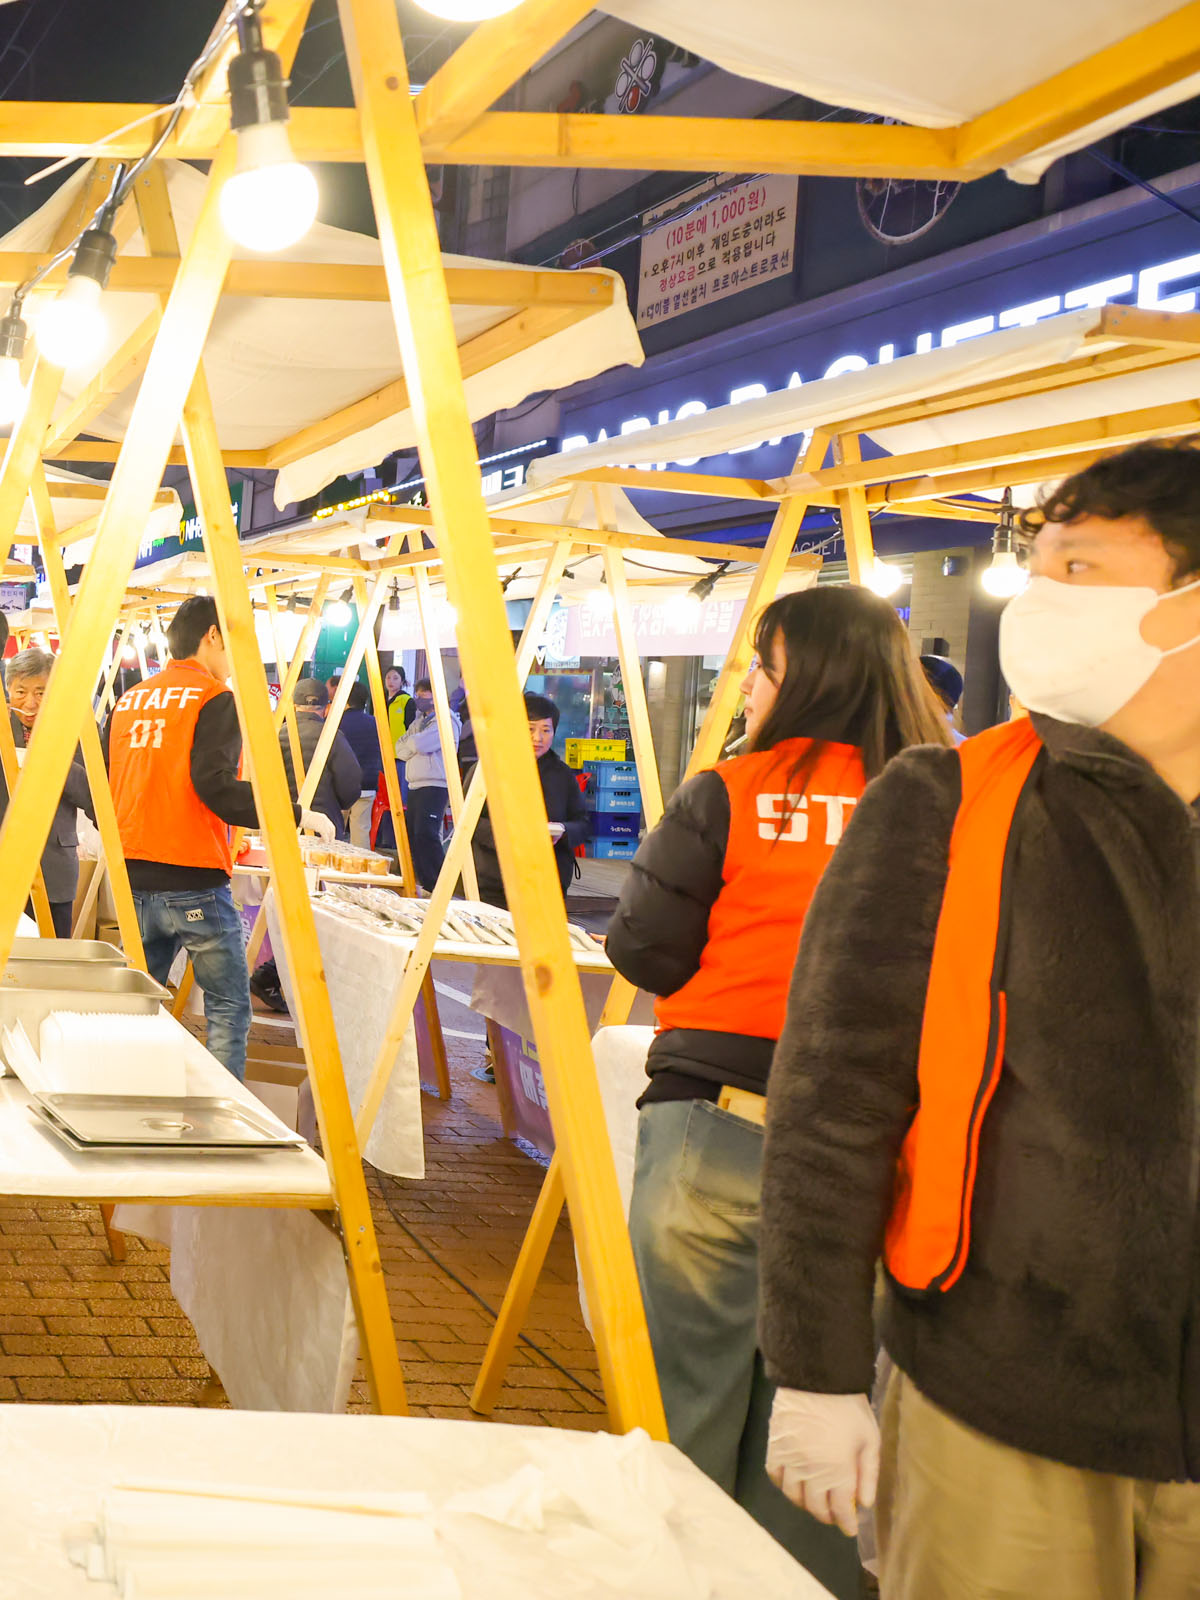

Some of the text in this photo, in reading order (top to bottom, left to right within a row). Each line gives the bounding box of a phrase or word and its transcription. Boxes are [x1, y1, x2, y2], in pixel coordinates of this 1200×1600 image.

[666, 215, 707, 250] (10분에
[711, 186, 767, 229] 1,000원)
[659, 231, 776, 292] 정상요금으로 적용됩니다
[116, 687, 203, 712] STAFF
[130, 718, 166, 748] 01
